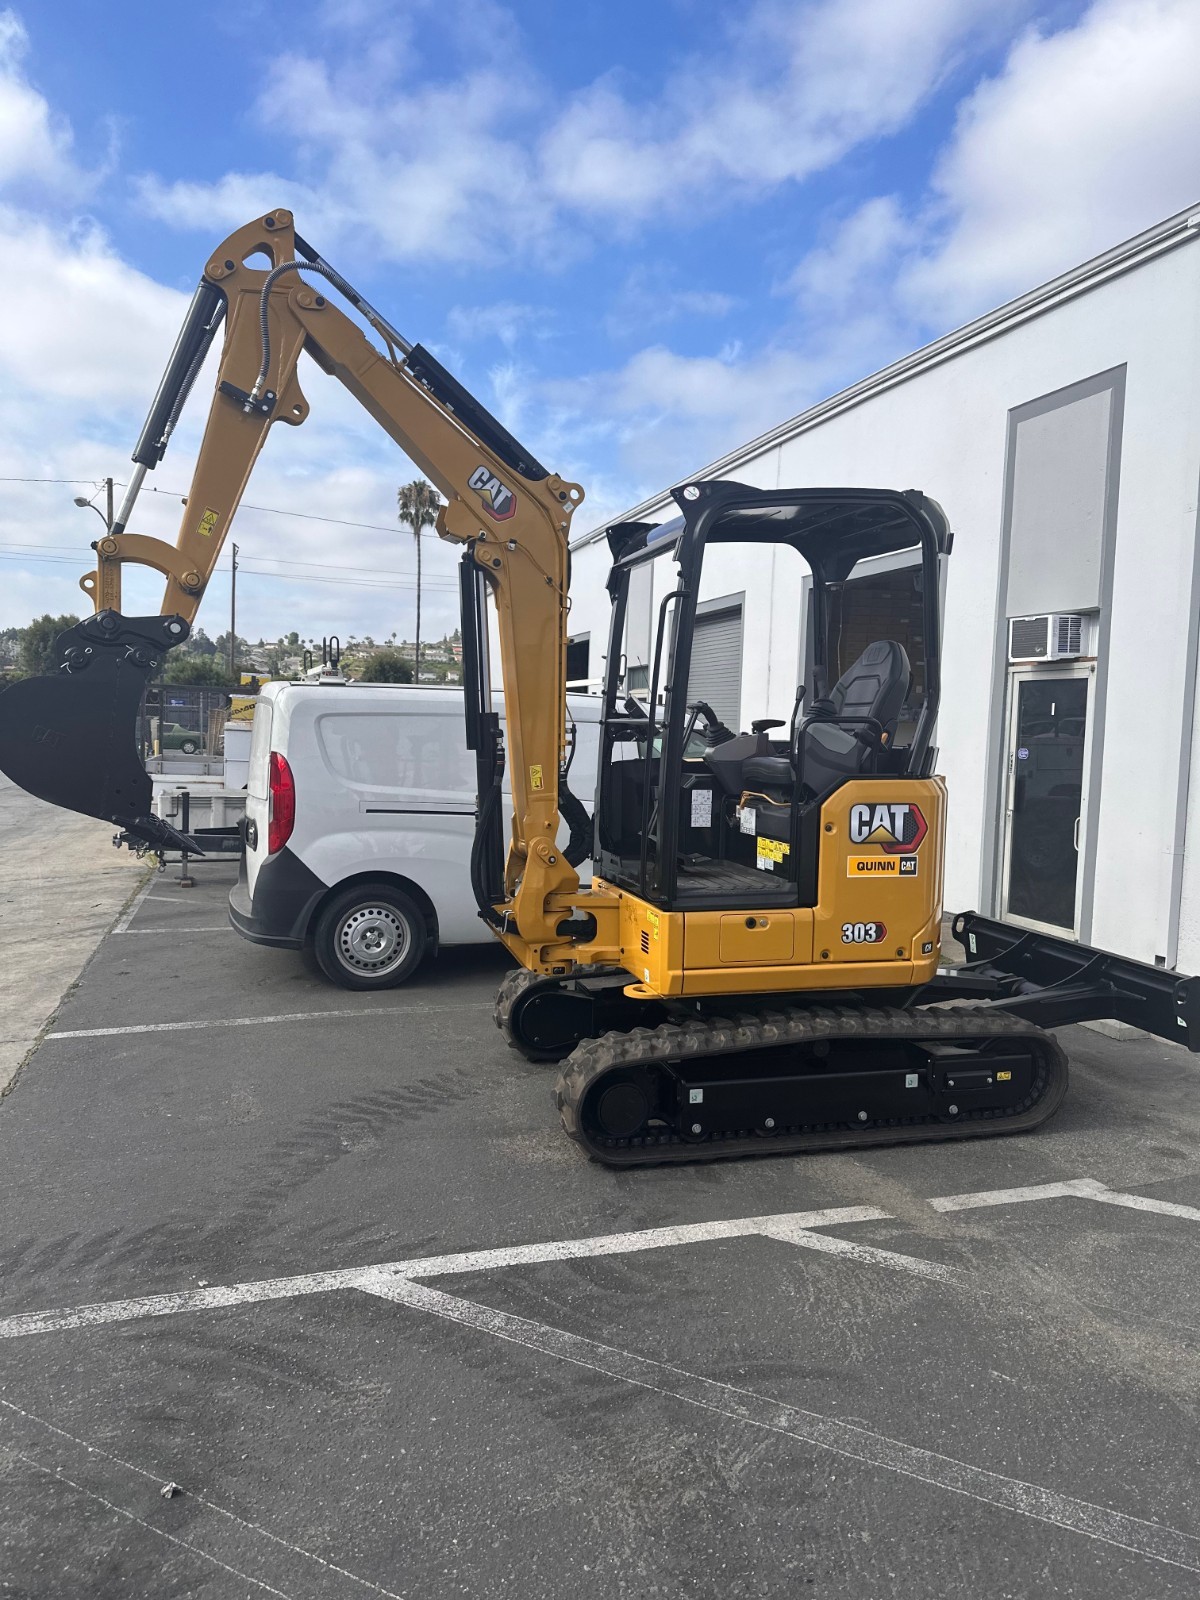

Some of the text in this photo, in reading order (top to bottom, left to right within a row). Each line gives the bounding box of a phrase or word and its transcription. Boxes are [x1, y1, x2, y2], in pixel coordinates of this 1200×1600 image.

[468, 466, 513, 511] CAT
[850, 804, 910, 843] CAT
[856, 861, 916, 871] QUINN CAT
[841, 922, 877, 943] 303
